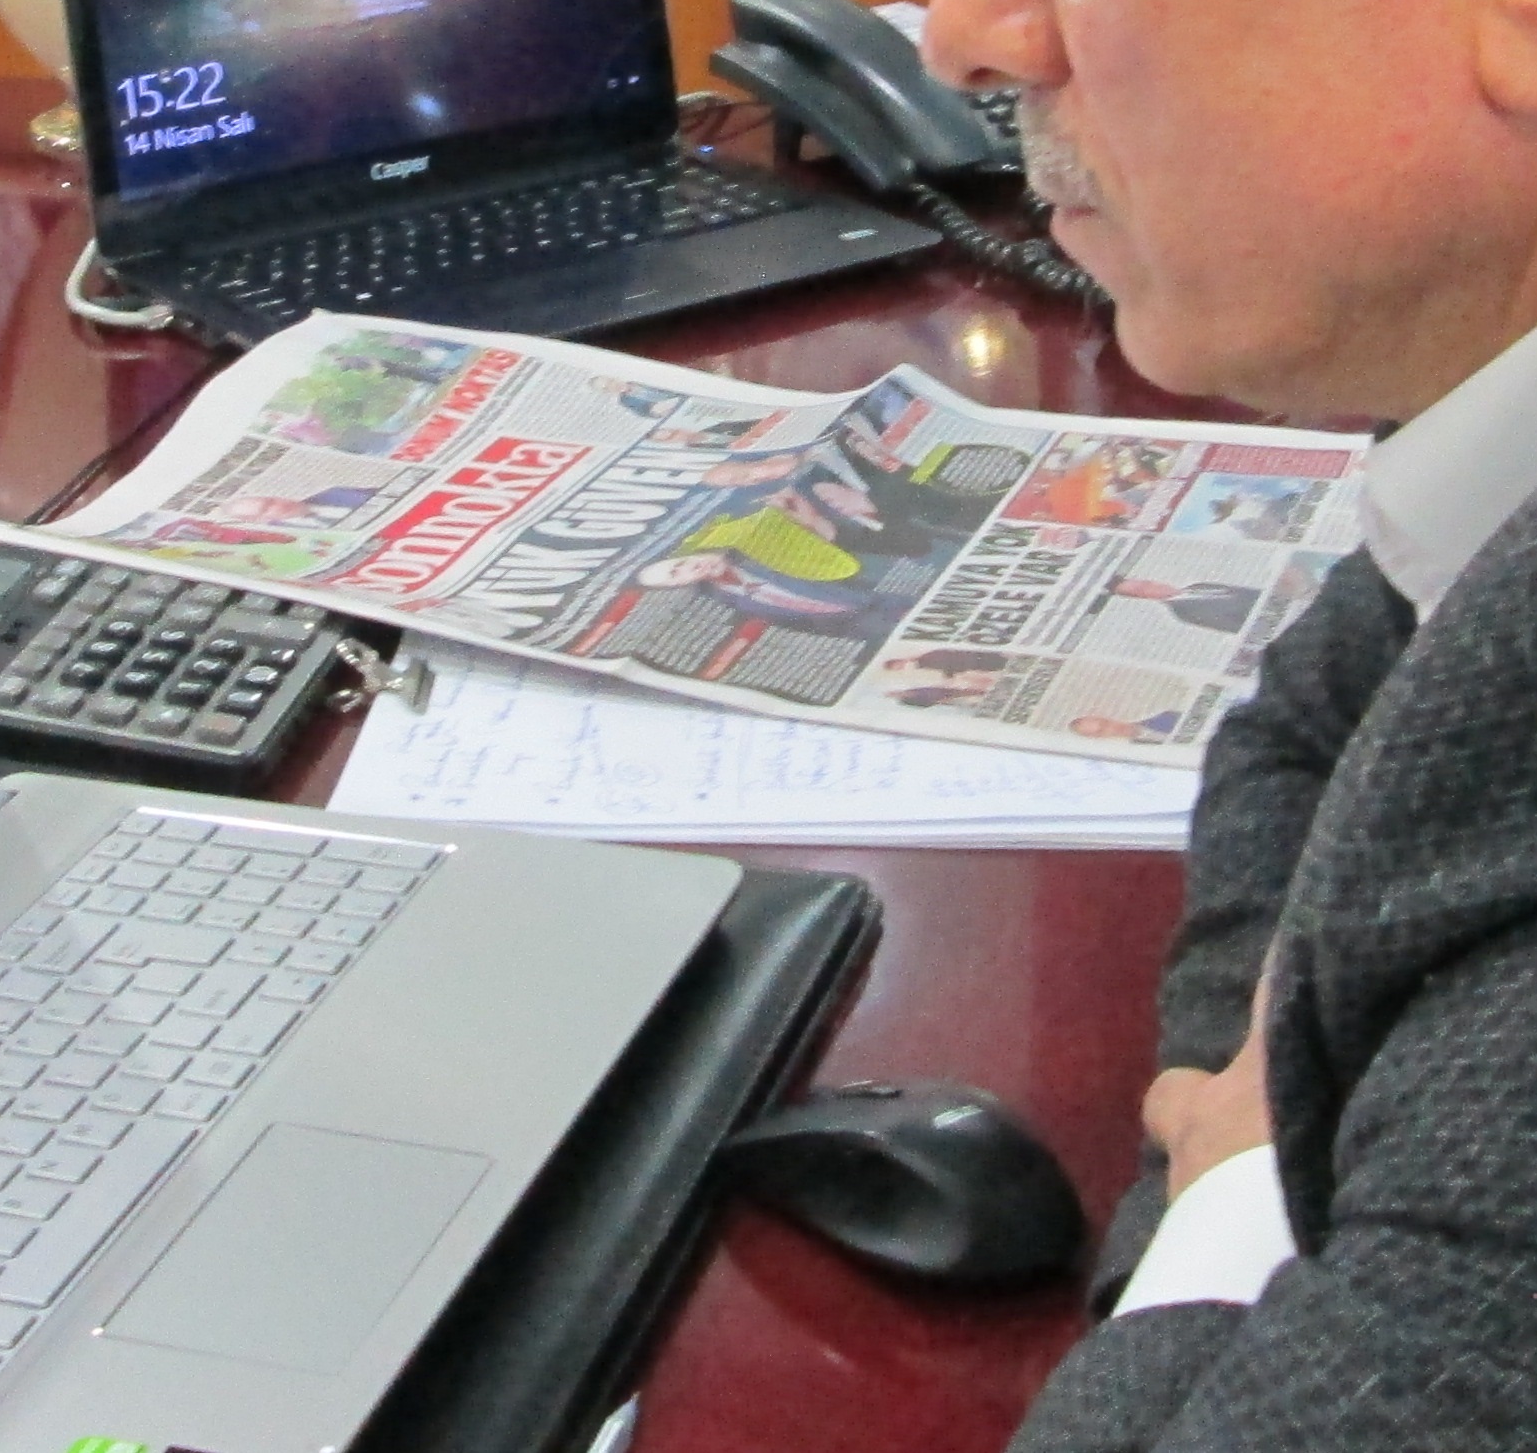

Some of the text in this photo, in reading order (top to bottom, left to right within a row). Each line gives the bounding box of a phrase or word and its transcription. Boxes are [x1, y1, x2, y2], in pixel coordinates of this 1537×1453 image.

[117, 61, 226, 120] 15:22
[123, 131, 152, 156] 14
[153, 124, 216, 151] Nisan
[369, 155, 431, 181] Casper
[1002, 550, 1079, 585] VAR
